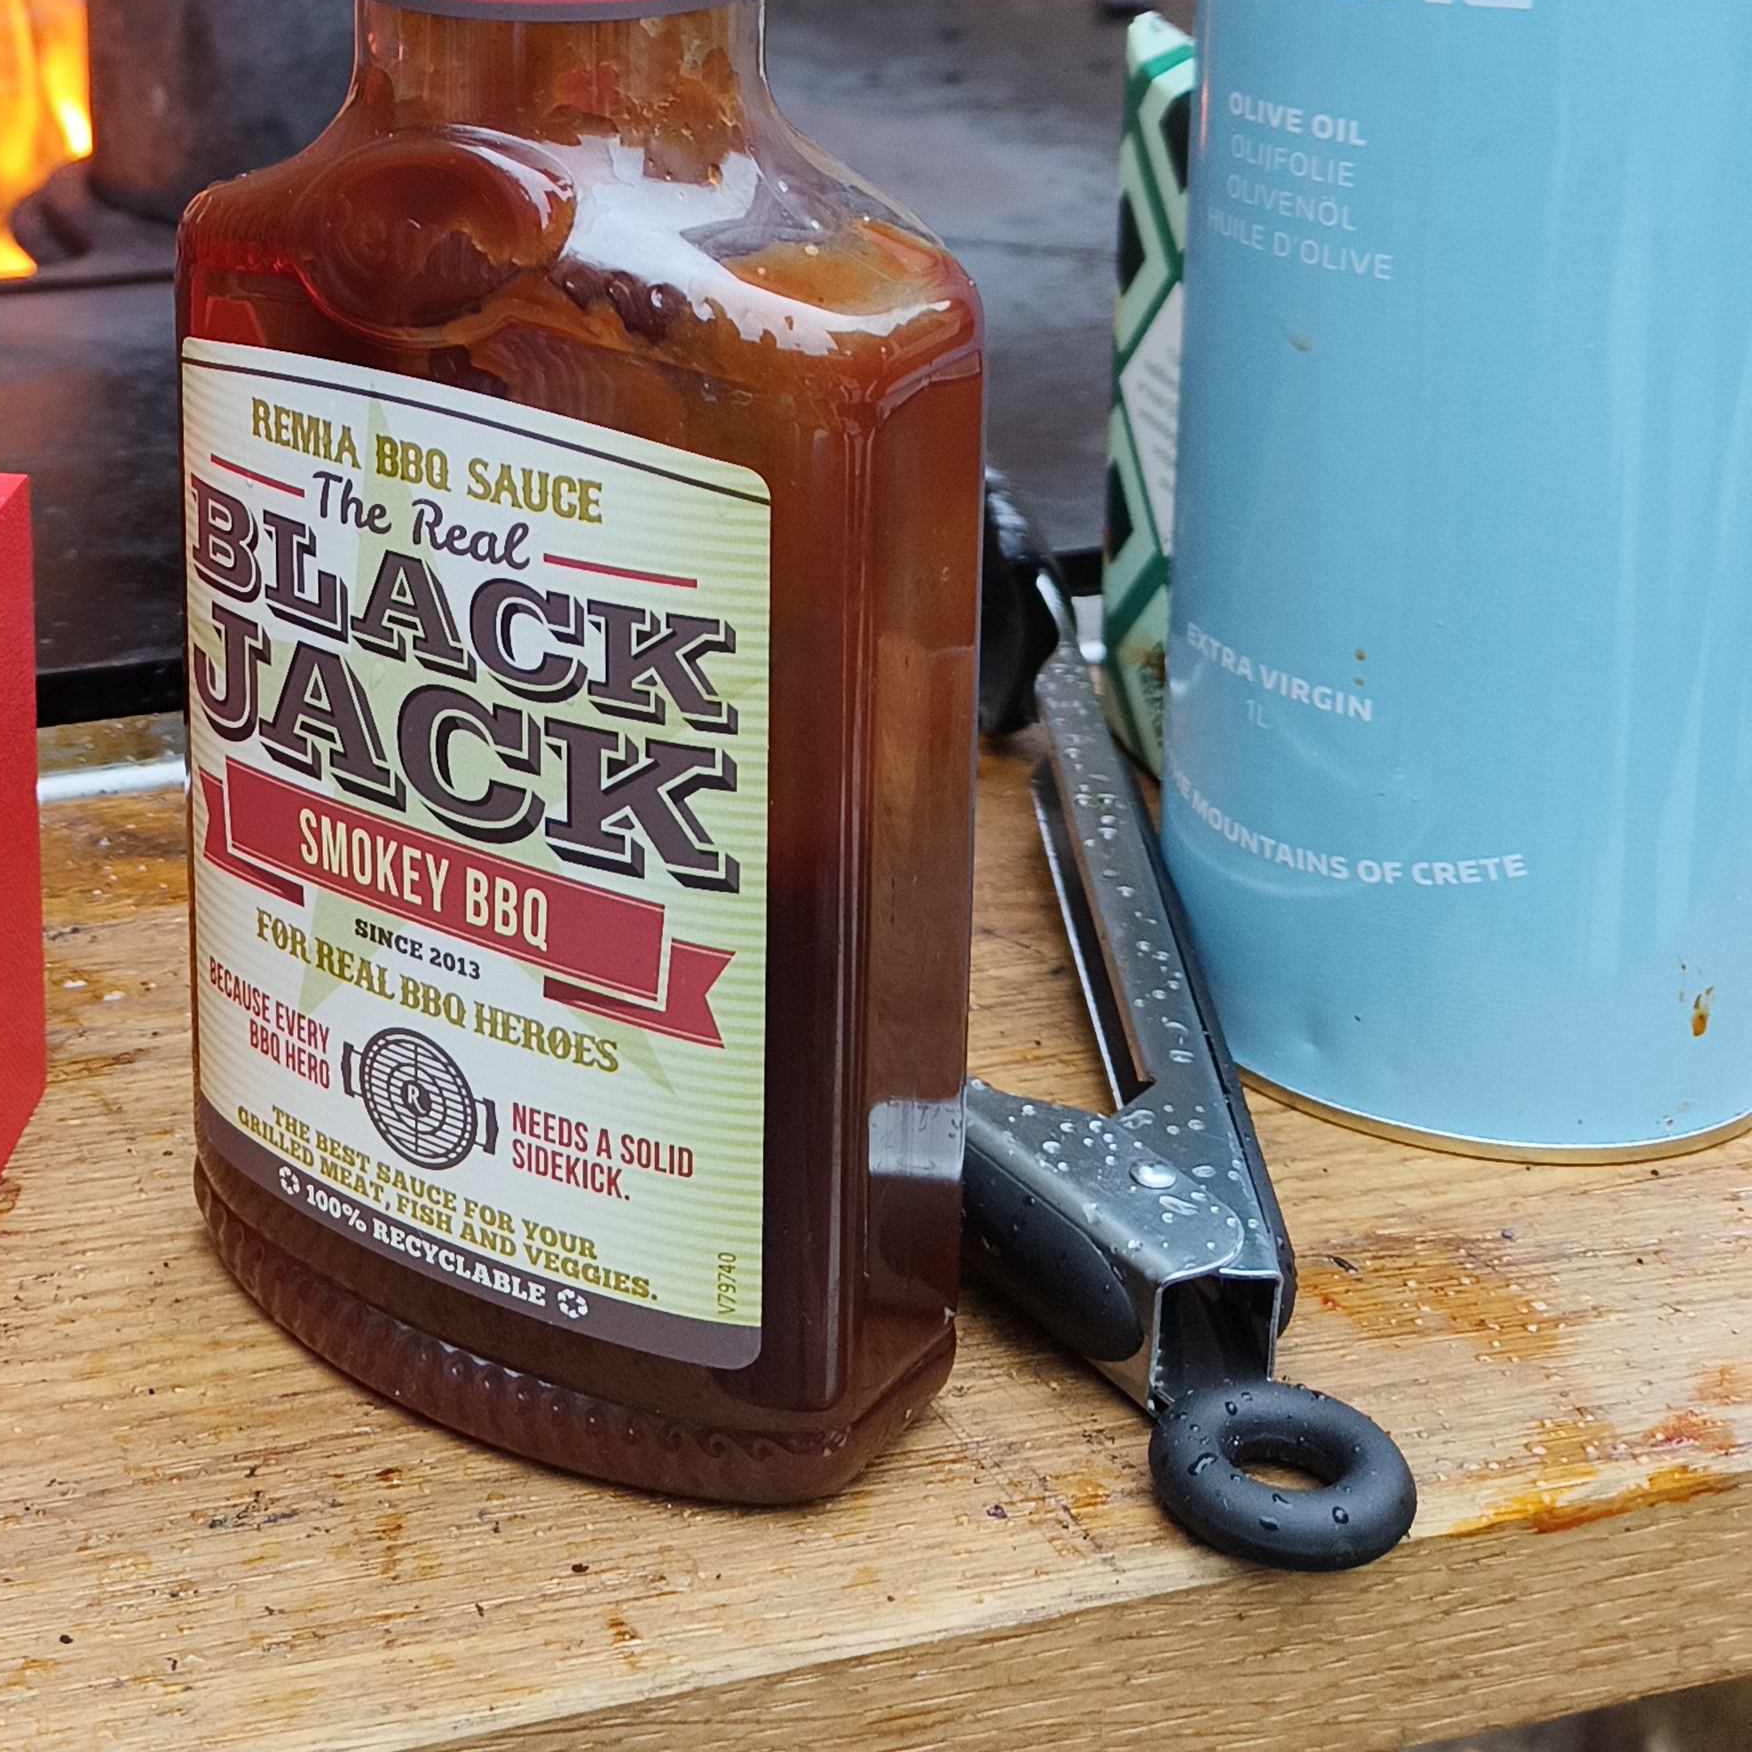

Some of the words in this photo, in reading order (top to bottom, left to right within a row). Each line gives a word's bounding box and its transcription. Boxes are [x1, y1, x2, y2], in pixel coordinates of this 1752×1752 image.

[1229, 91, 1303, 135] OLIVE
[1310, 114, 1366, 147] OIL
[1231, 134, 1355, 188] OLIJFOLIE
[1207, 206, 1265, 251] HUILE
[1273, 230, 1394, 280] D'OLIVE
[1227, 174, 1356, 232] OLIVENÖL
[251, 396, 362, 469] REMIA
[375, 433, 452, 493] BBQ
[467, 458, 603, 524] SAUCE
[312, 470, 392, 535] The
[412, 498, 530, 570] Real
[191, 474, 738, 735] BLACK
[1186, 621, 1254, 682] EXTRA
[1259, 664, 1373, 722] VIRGIN
[193, 600, 740, 894] JACK
[299, 807, 449, 913] SMOKEY
[465, 866, 548, 952] BBQ
[1191, 791, 1349, 879] MOUNTAINS
[1356, 859, 1403, 884] OF
[1411, 853, 1528, 886] CRETE
[314, 936, 395, 1000] REAL
[398, 974, 467, 1029] BBQ
[354, 918, 423, 961] SINCE
[429, 947, 481, 980] 2013
[209, 955, 271, 1024] BECAUSE
[275, 1000, 330, 1054] EVERY
[248, 1018, 282, 1065] BBQ
[285, 1039, 331, 1090] HERO
[272, 1105, 310, 1145] THE
[315, 1129, 370, 1173] BEST
[376, 1161, 457, 1213] SAUCE
[463, 1196, 515, 1235] FOR
[521, 1218, 598, 1260] YOUR
[511, 1102, 588, 1153] NEEDS
[596, 1127, 612, 1160] A
[620, 1133, 694, 1178] SOLID
[511, 1138, 630, 1201] SIDEKICK.
[237, 1105, 315, 1168] GRILLED
[319, 1156, 391, 1211] MEAT,
[397, 1197, 453, 1235] FISH
[459, 1220, 517, 1258] AND
[523, 1243, 658, 1301] VEGGIES.
[306, 1184, 368, 1233] 100%
[372, 1217, 546, 1308] RECYCLABLE
[717, 1251, 737, 1316] V79740
